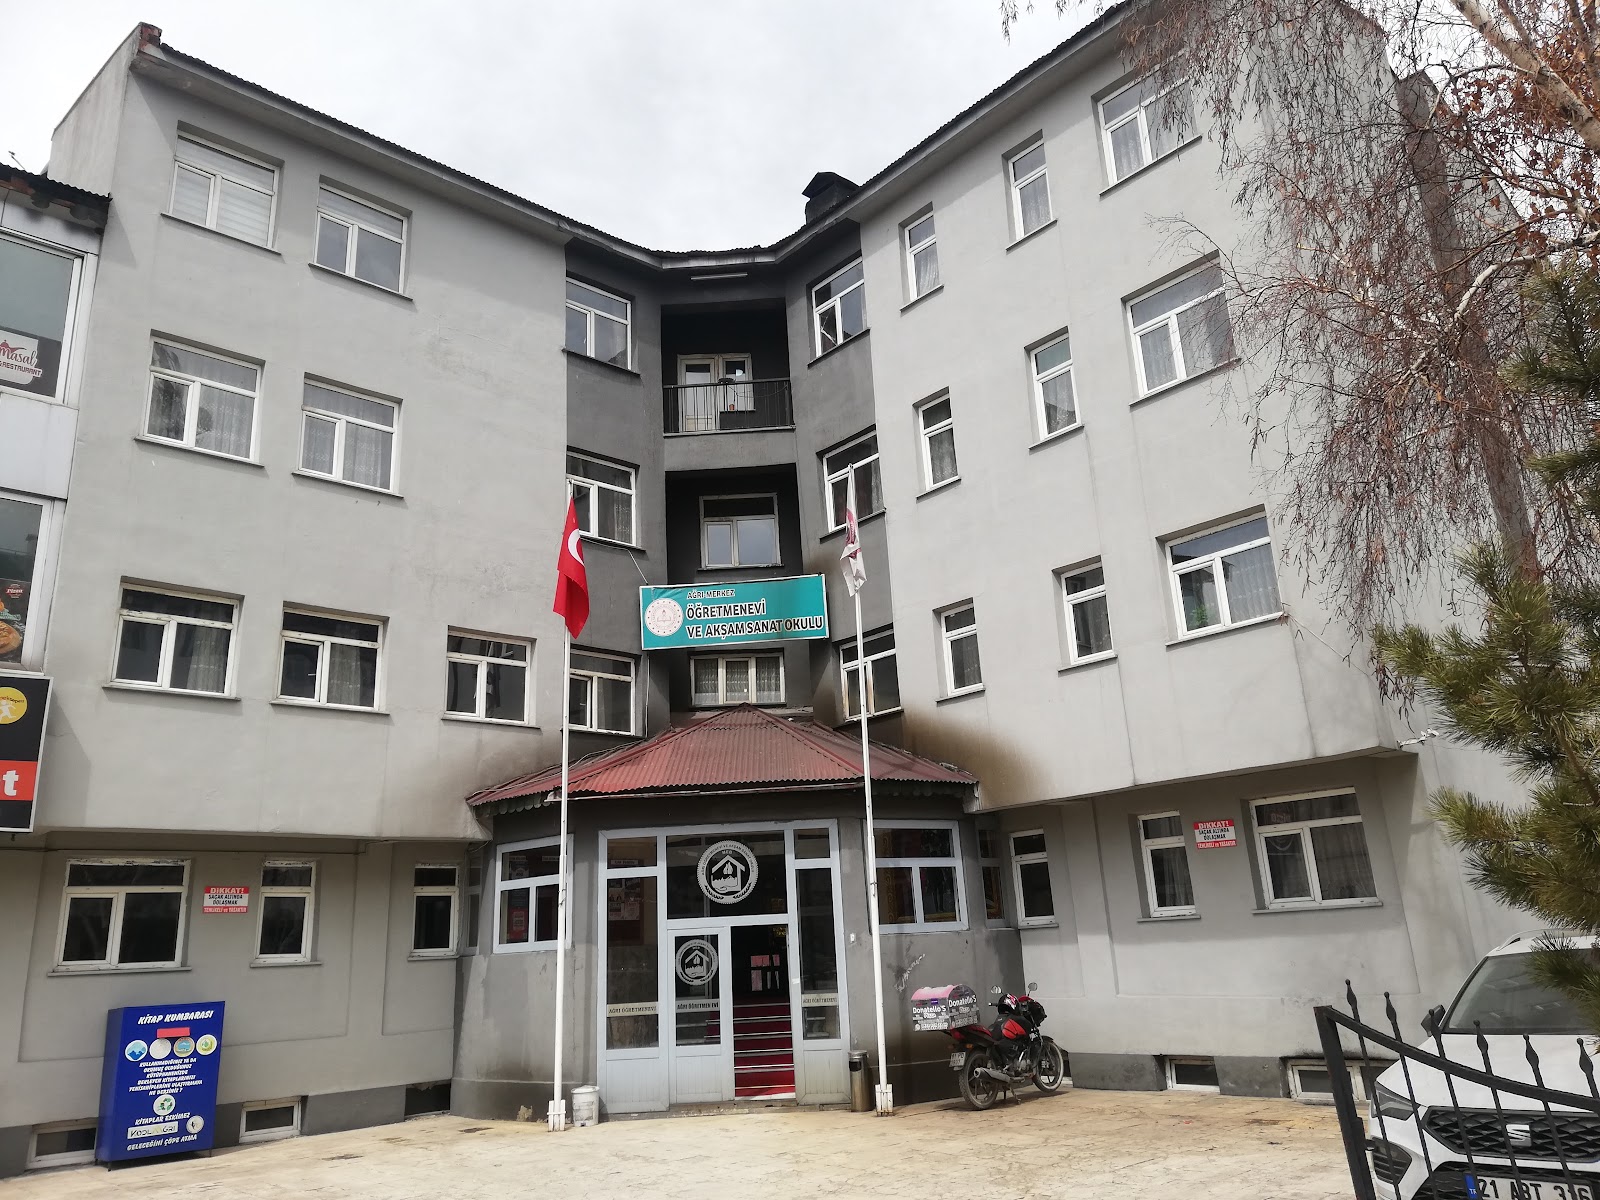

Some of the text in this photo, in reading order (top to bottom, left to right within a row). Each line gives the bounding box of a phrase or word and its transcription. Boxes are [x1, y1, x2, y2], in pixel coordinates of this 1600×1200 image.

[706, 588, 735, 598] MERKEZ
[686, 598, 766, 619] ÖĞRETMENEVİ
[686, 616, 823, 640] VE AKŞAM SANAT OKULU
[138, 1010, 214, 1024] KİTAP KUMBARASI
[135, 1112, 191, 1126] KİTAPLAR ESKİMEZ
[127, 1133, 198, 1151] GELECEĞİNİ ÇÖPE ATMA
[1478, 1178, 1500, 1199] 21
[1553, 1185, 1591, 1200] 36
